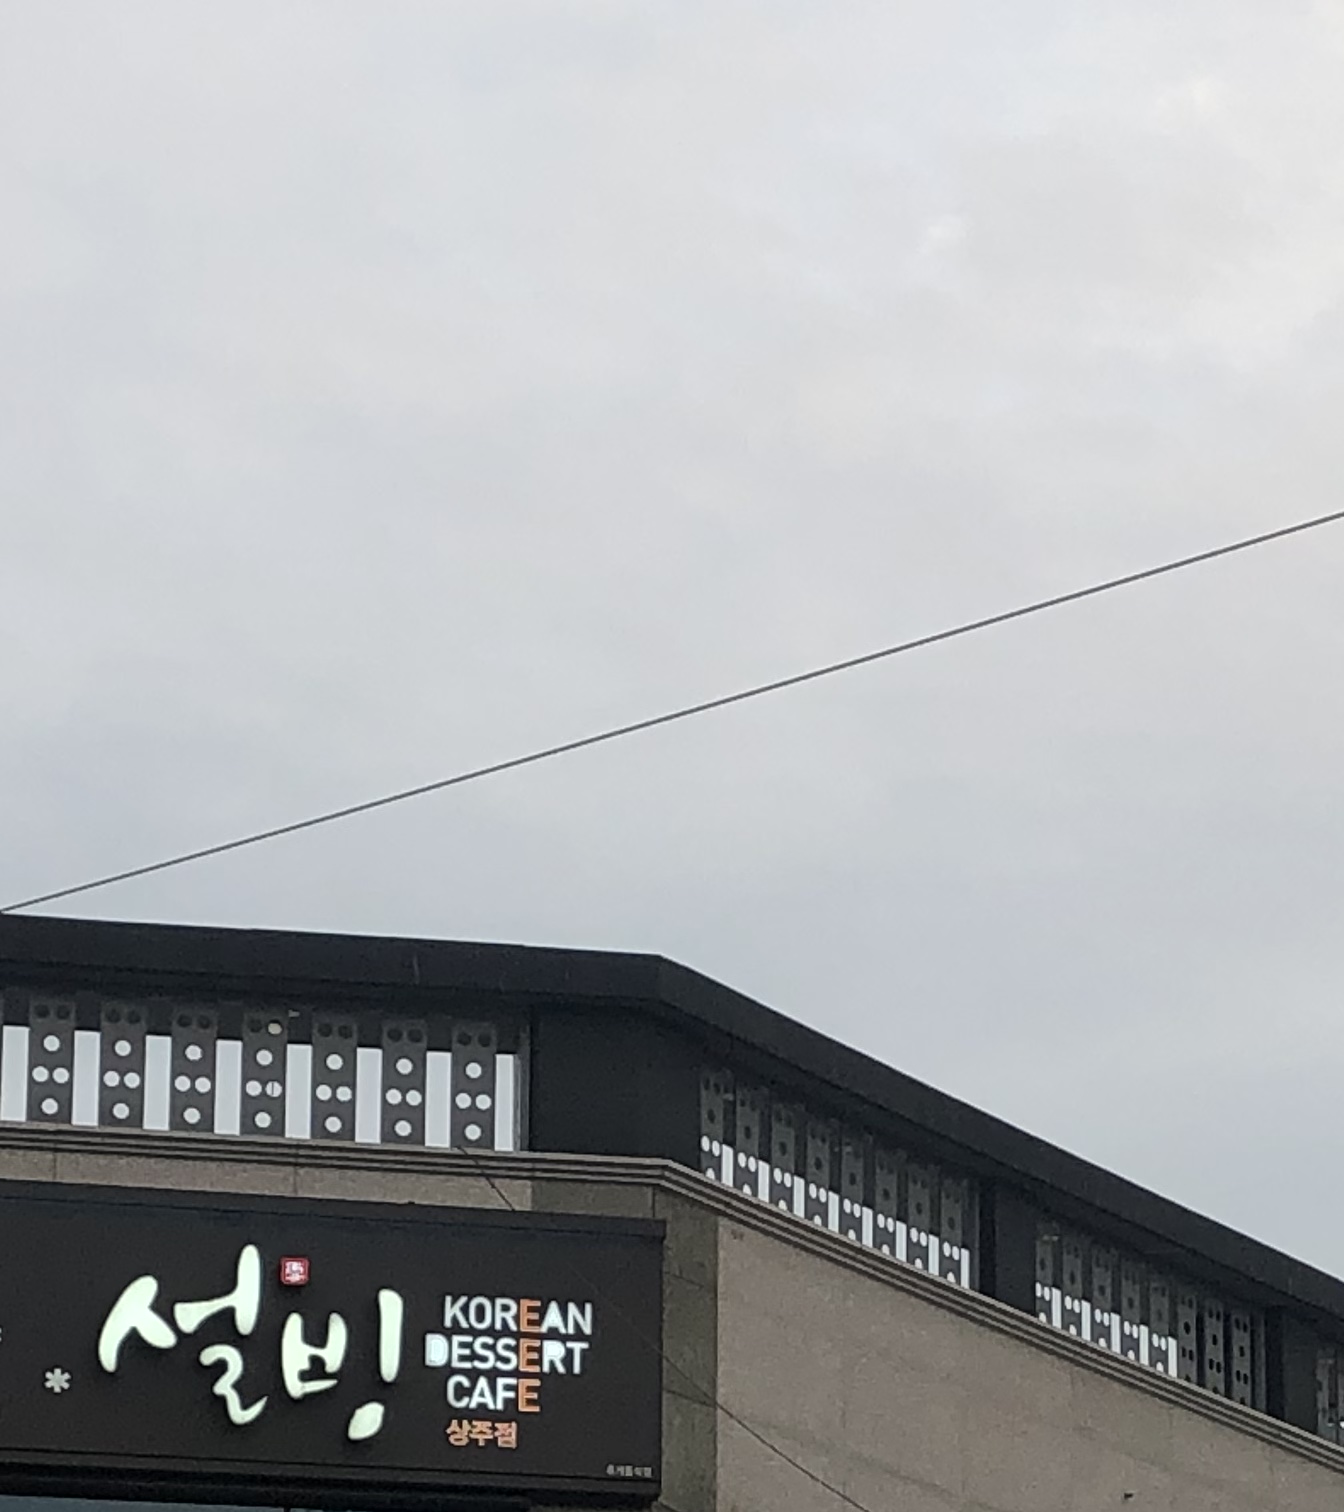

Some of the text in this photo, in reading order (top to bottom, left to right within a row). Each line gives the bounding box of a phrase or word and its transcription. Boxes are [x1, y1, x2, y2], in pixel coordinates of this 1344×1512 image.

[443, 1296, 593, 1336] KOREAN
[98, 1244, 403, 1441] 설빙
[424, 1332, 589, 1375] DESSERT
[446, 1374, 541, 1413] CAFE
[445, 1419, 518, 1449] 상주점
